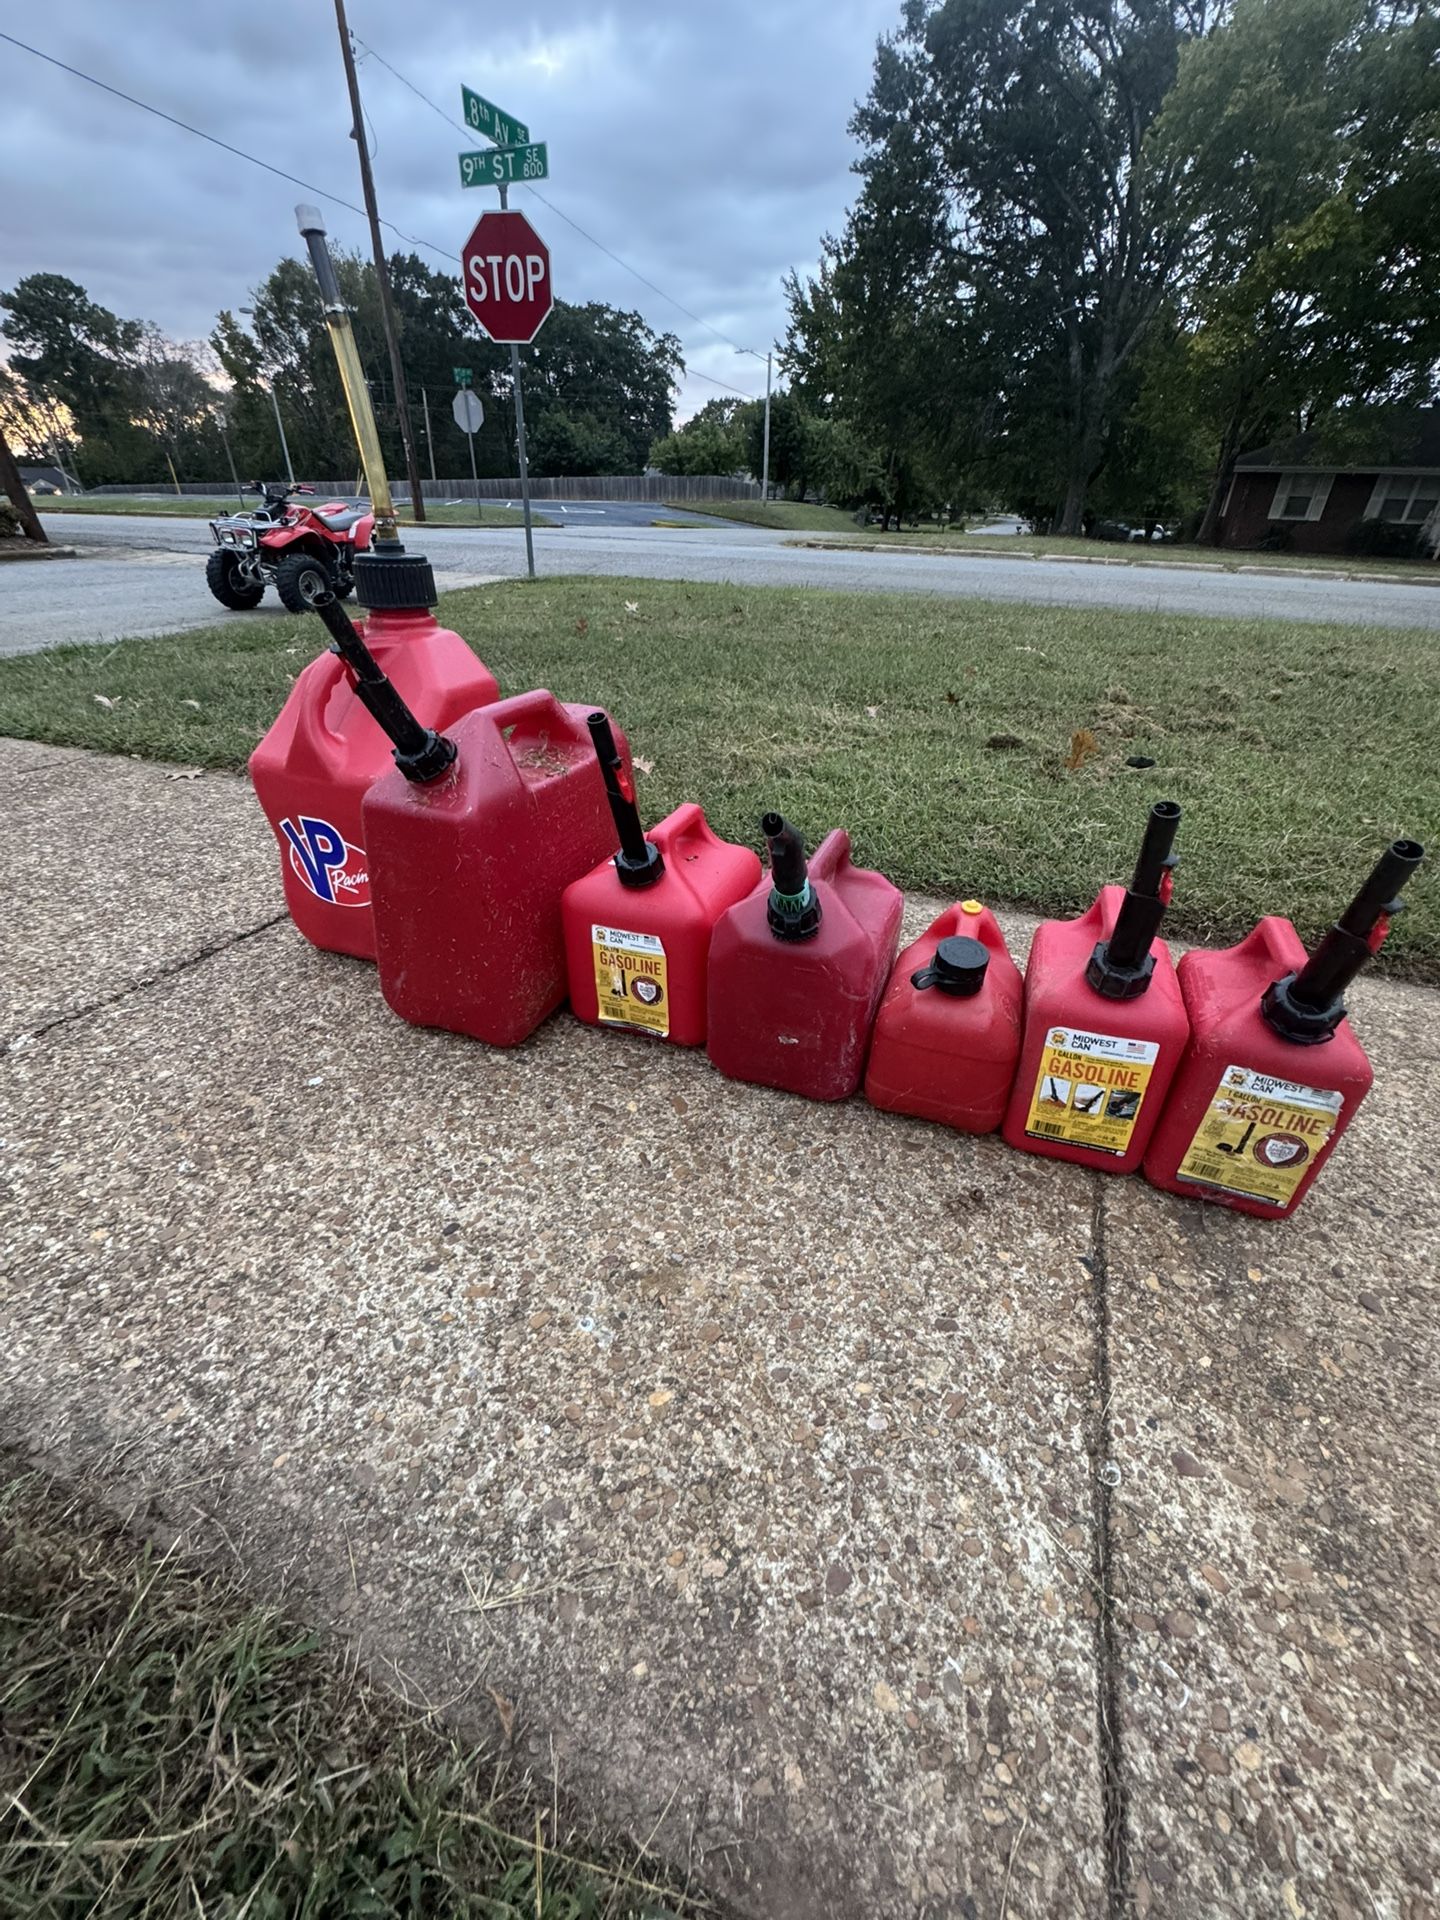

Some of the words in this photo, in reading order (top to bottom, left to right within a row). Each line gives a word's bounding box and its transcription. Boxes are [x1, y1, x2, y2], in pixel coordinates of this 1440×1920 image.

[470, 97, 490, 127] 8th
[462, 156, 486, 182] 9TH
[492, 152, 515, 179] ST
[526, 147, 538, 163] SE
[523, 161, 544, 177] 800
[469, 254, 545, 302] STOP
[279, 814, 348, 904] VP
[331, 868, 369, 894] Racin
[609, 930, 640, 942] MIDWEST
[609, 936, 624, 945] CAN
[600, 951, 663, 976] GASOLINE
[1071, 1040, 1092, 1051] CAN
[1072, 1034, 1118, 1049] MIDWEST
[1059, 1050, 1083, 1061] GALLON
[1048, 1057, 1141, 1089] GASOLINE
[1251, 1082, 1275, 1095] CAN
[1253, 1075, 1307, 1094] MIDWEST
[1234, 1090, 1263, 1105] GALLON
